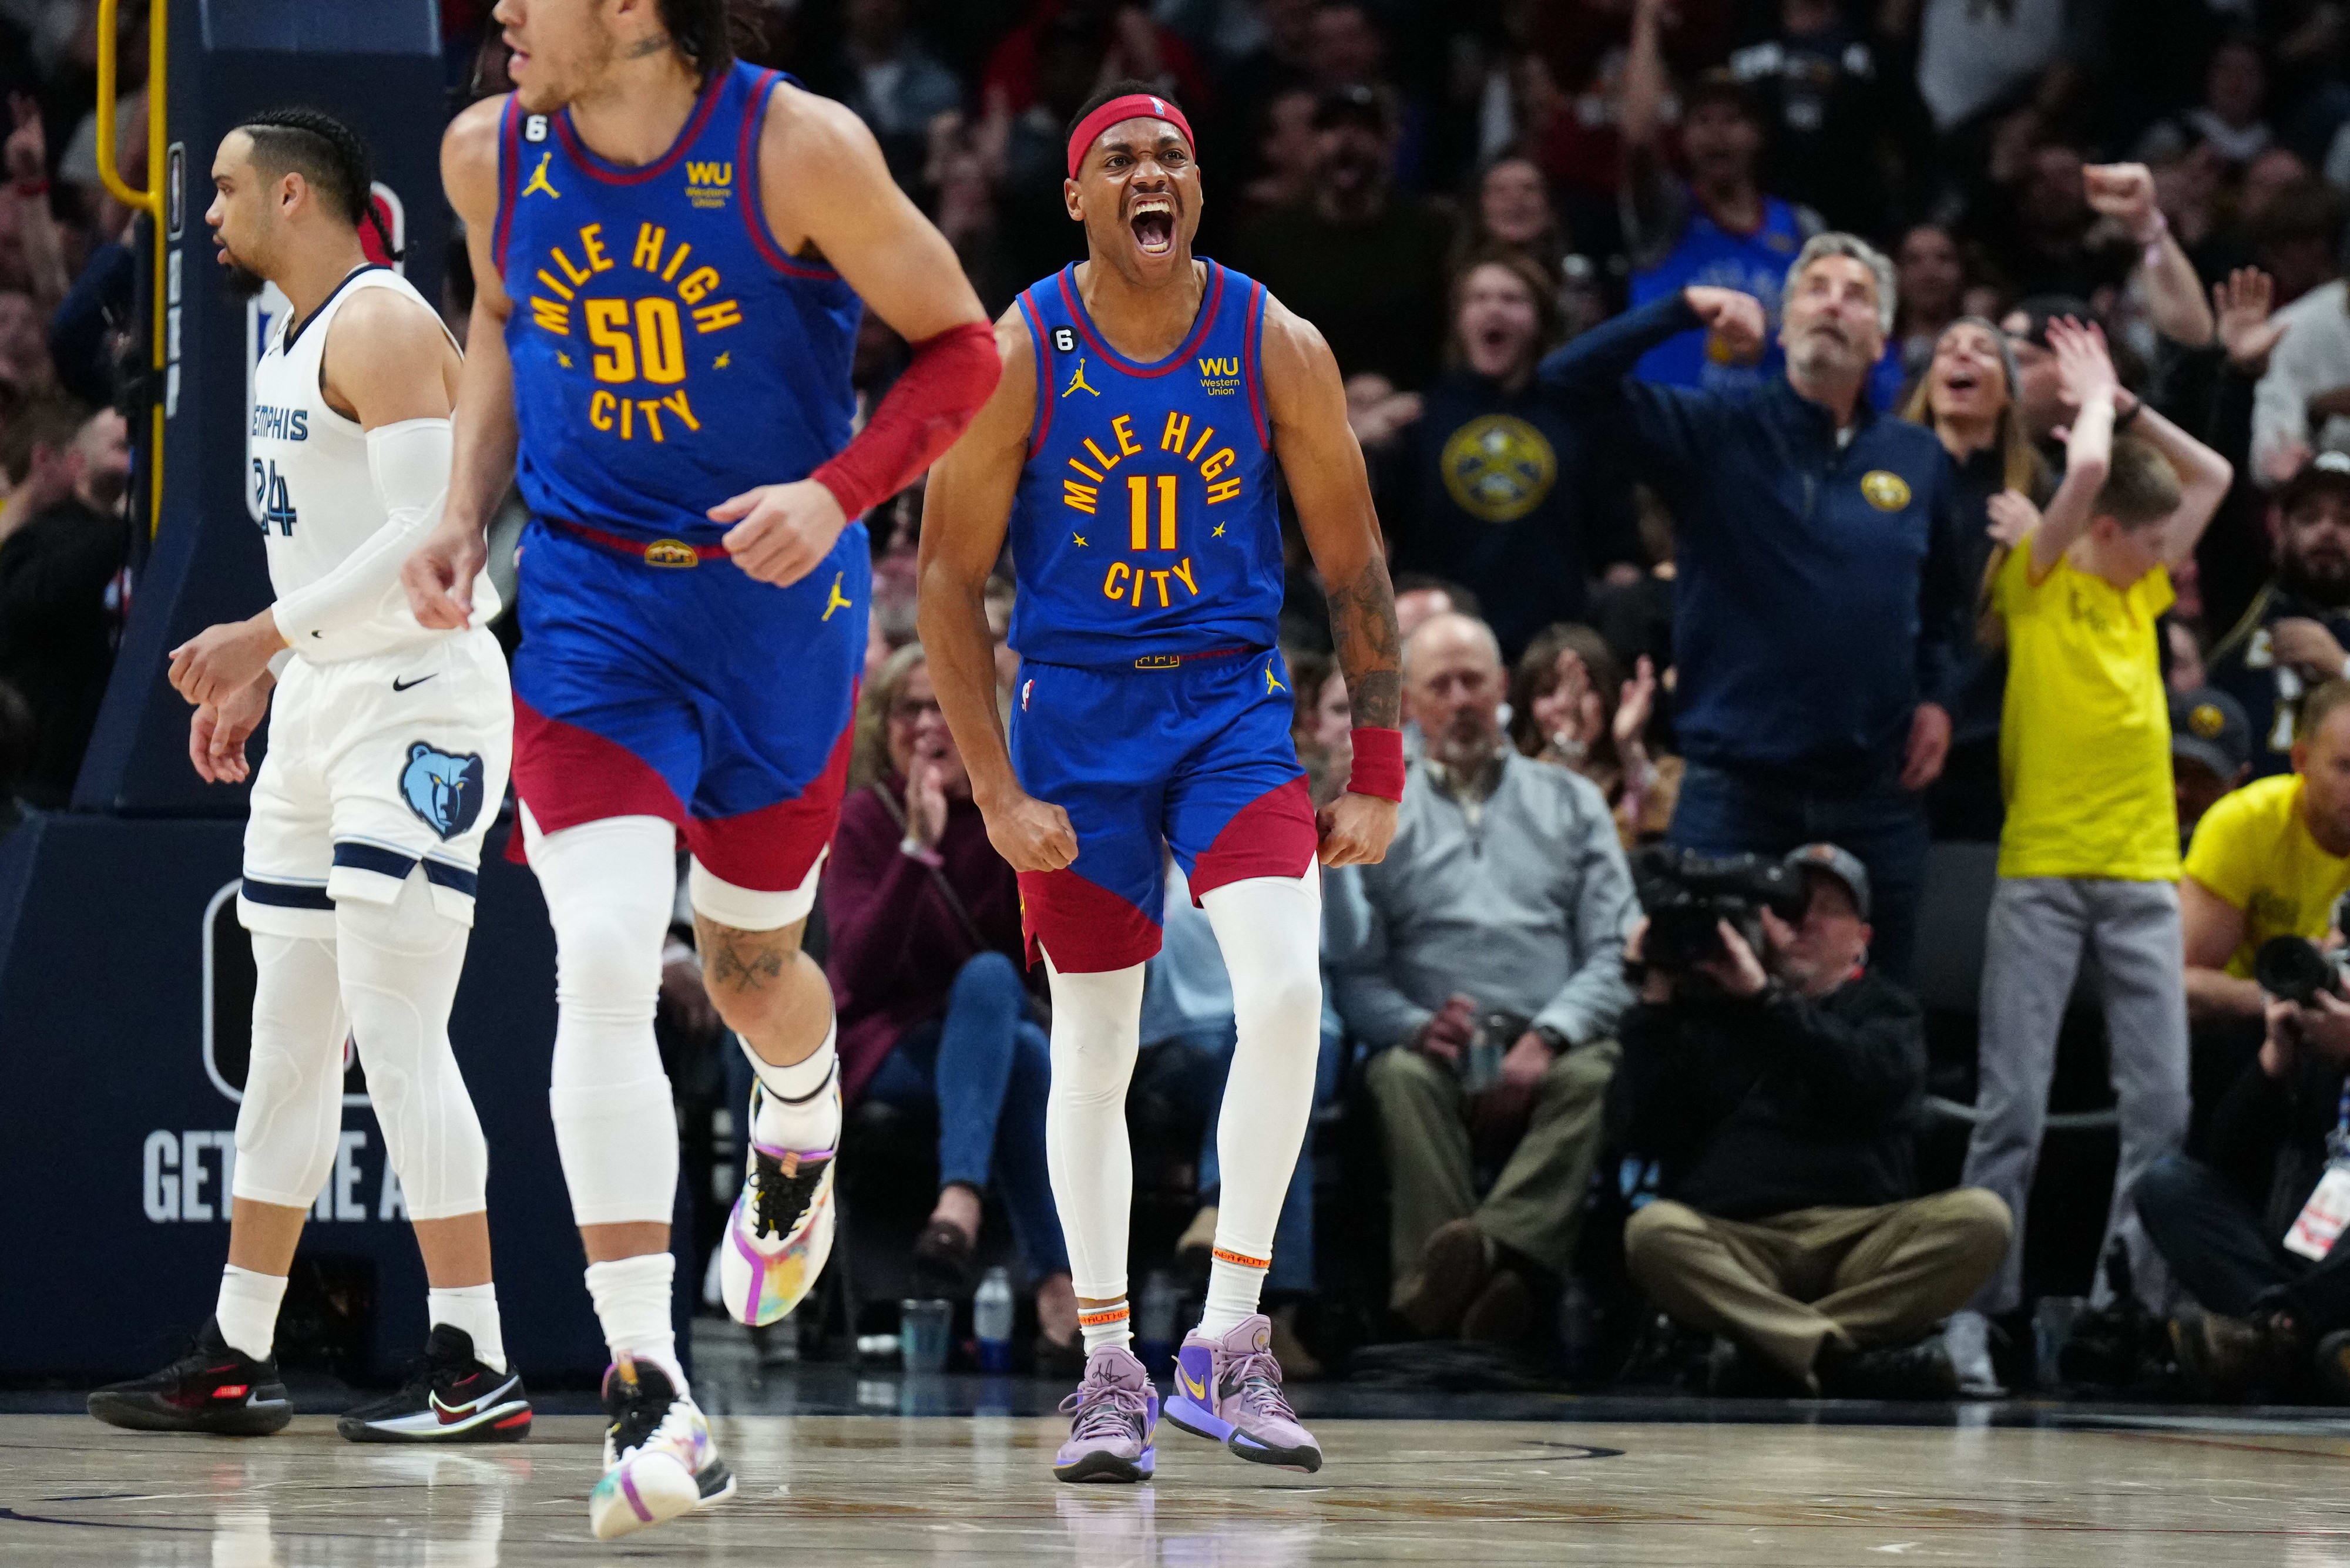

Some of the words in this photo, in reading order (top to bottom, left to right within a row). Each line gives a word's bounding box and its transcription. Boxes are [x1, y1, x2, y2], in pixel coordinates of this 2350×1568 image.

[526, 115, 548, 142] 6
[686, 161, 732, 186] WU
[530, 222, 615, 336] MILE
[631, 221, 743, 334] HIGH
[583, 296, 687, 385] 50
[1056, 329, 1073, 351] 6
[1198, 357, 1239, 377] WU
[1200, 378, 1240, 387] Western
[1207, 386, 1234, 396] Union
[253, 405, 308, 441] EMPHIS
[589, 389, 701, 444] CITY
[1063, 413, 1142, 515] MILE
[1160, 411, 1241, 506] HIGH
[1126, 474, 1177, 551] 11
[1102, 557, 1200, 607] CITY
[1214, 1250, 1234, 1261] NBA
